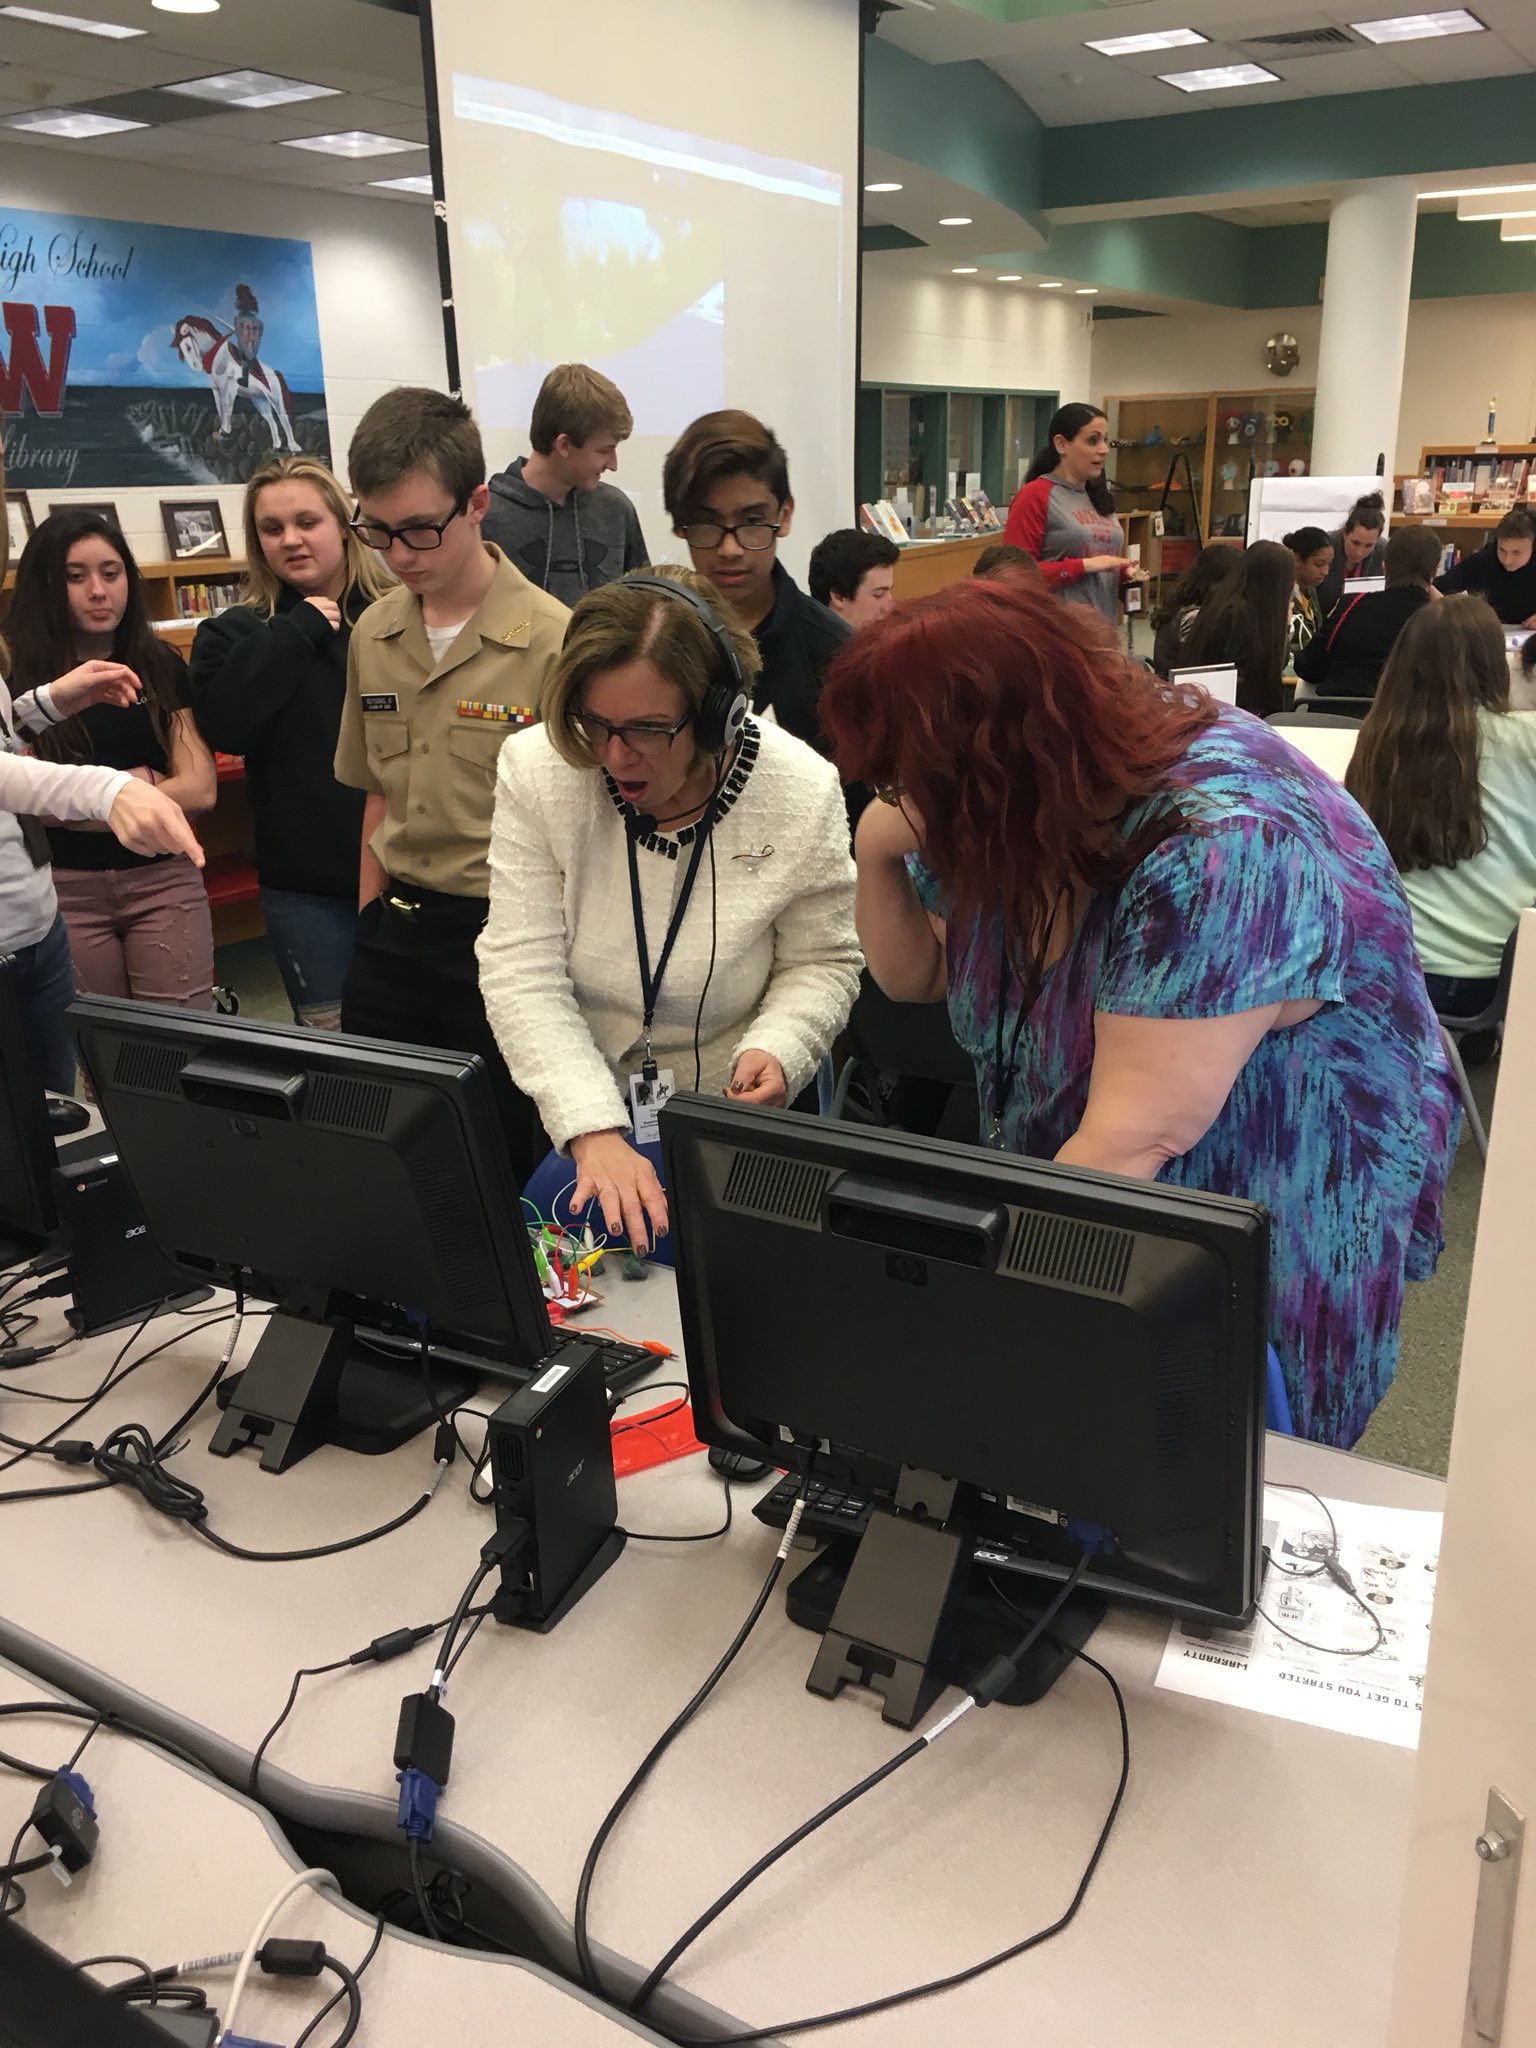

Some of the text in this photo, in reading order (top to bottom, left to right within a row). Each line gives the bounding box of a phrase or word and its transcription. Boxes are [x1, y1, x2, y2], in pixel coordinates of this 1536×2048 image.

[0, 224, 134, 293] igh School
[125, 1224, 147, 1239] ace
[566, 1457, 585, 1487] acer
[973, 1550, 1009, 1562] acer
[1183, 1650, 1248, 1671] WARRANTY
[1277, 1672, 1334, 1691] STARTED
[1336, 1684, 1361, 1698] YOU
[1366, 1691, 1389, 1704] GET
[1393, 1698, 1410, 1710] TO
